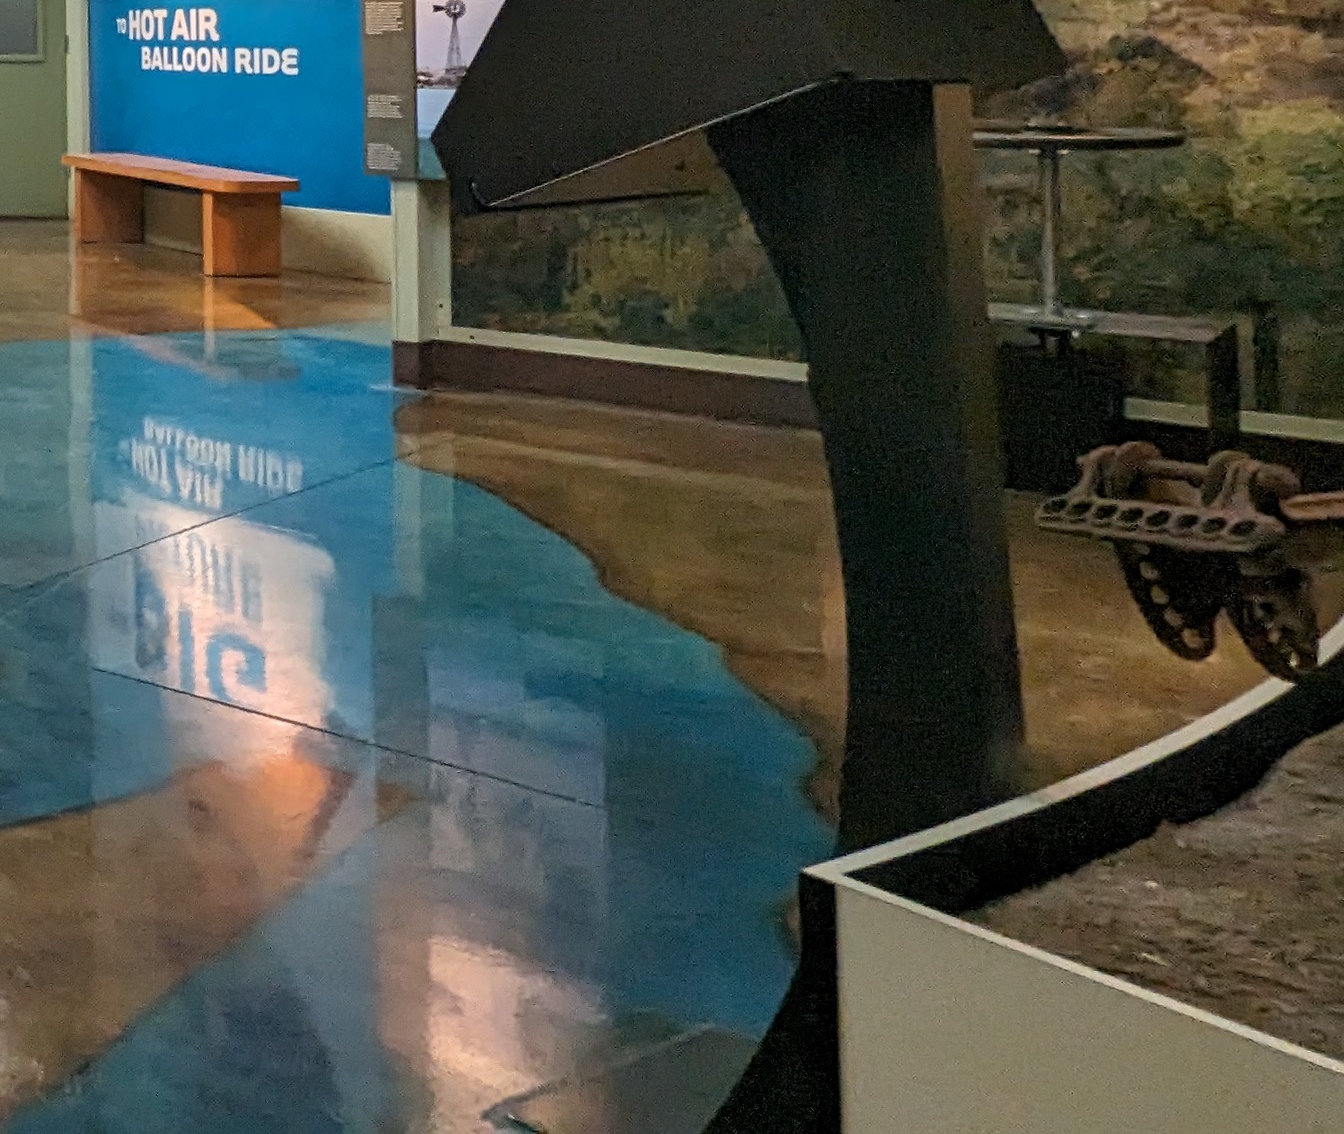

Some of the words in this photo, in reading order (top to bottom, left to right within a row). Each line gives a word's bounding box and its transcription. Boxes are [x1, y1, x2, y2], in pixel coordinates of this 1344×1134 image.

[128, 8, 168, 41] HOT
[170, 7, 220, 42] AIR
[140, 46, 228, 74] BALLOON
[234, 47, 299, 76] RIDE
